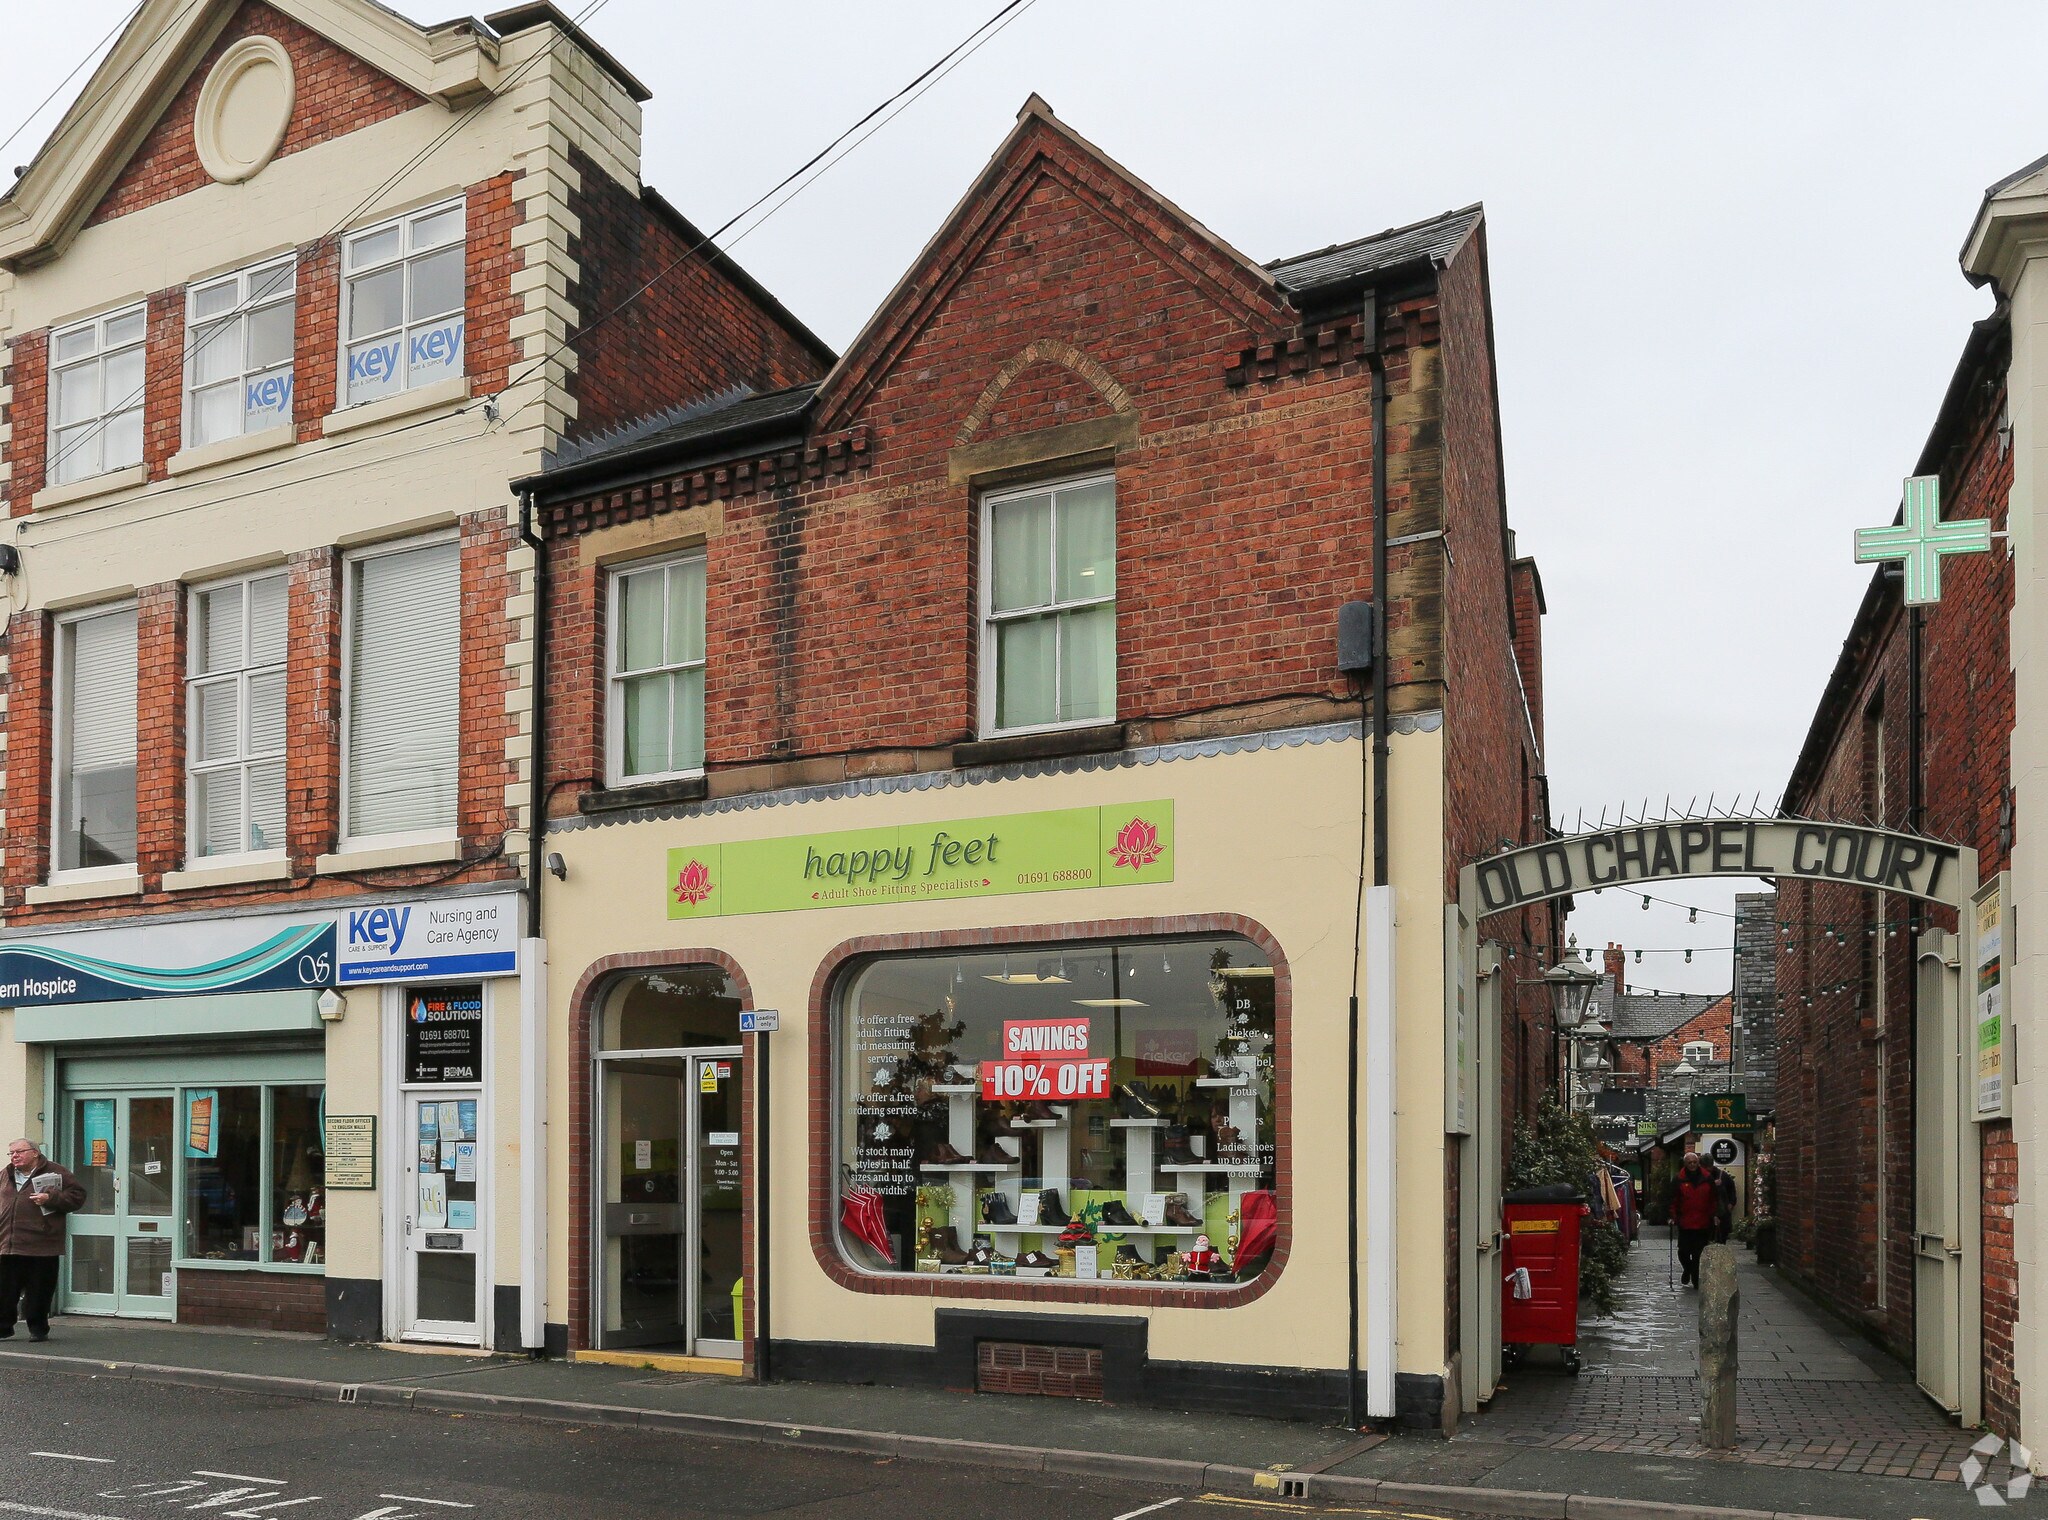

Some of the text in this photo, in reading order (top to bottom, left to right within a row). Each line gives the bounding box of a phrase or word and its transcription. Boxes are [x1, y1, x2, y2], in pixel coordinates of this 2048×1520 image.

[410, 324, 464, 366] key
[350, 342, 400, 383] key
[247, 374, 294, 413] key
[803, 832, 999, 884] happy feet
[1478, 822, 1958, 911] OLD CHAPEL COURT
[1017, 868, 1092, 885] 01691 688800
[821, 878, 979, 900] Adult Shoe Fitting Specialists
[429, 905, 498, 925] Nursing and
[349, 906, 411, 956] key
[427, 927, 500, 945] Care Agency
[348, 963, 429, 975] www.keycareandsupport.com
[23, 976, 77, 1000] Hospice
[427, 1001, 482, 1011] FIRE & FLOOD
[1236, 999, 1250, 1009] DB
[427, 1010, 482, 1021] SOLUTIONS
[866, 1014, 888, 1024] offer
[889, 1016, 895, 1024] a
[897, 1013, 915, 1024] free
[420, 1029, 470, 1040] 01691 688701
[856, 1027, 911, 1039] adults fitting
[1008, 1024, 1088, 1052] SAVINGS
[1227, 1028, 1260, 1038] Rieker
[869, 1040, 915, 1051] measuring
[867, 1053, 898, 1063] service
[1057, 1063, 1108, 1095] OFF
[866, 1092, 888, 1102] offer
[897, 1092, 915, 1102] free
[1229, 1087, 1257, 1096] Lotus
[848, 1105, 918, 1117] ordering service
[1717, 1106, 1733, 1121] R
[458, 1145, 473, 1157] key
[851, 1146, 915, 1158] We stock many
[1216, 1142, 1275, 1152] Ladies shoes
[856, 1159, 909, 1171] styles in half
[1231, 1156, 1241, 1165] to
[1242, 1155, 1261, 1165] size
[1263, 1155, 1274, 1165] 12
[850, 1172, 914, 1184] sizes and up to
[877, 1185, 907, 1195] widths
